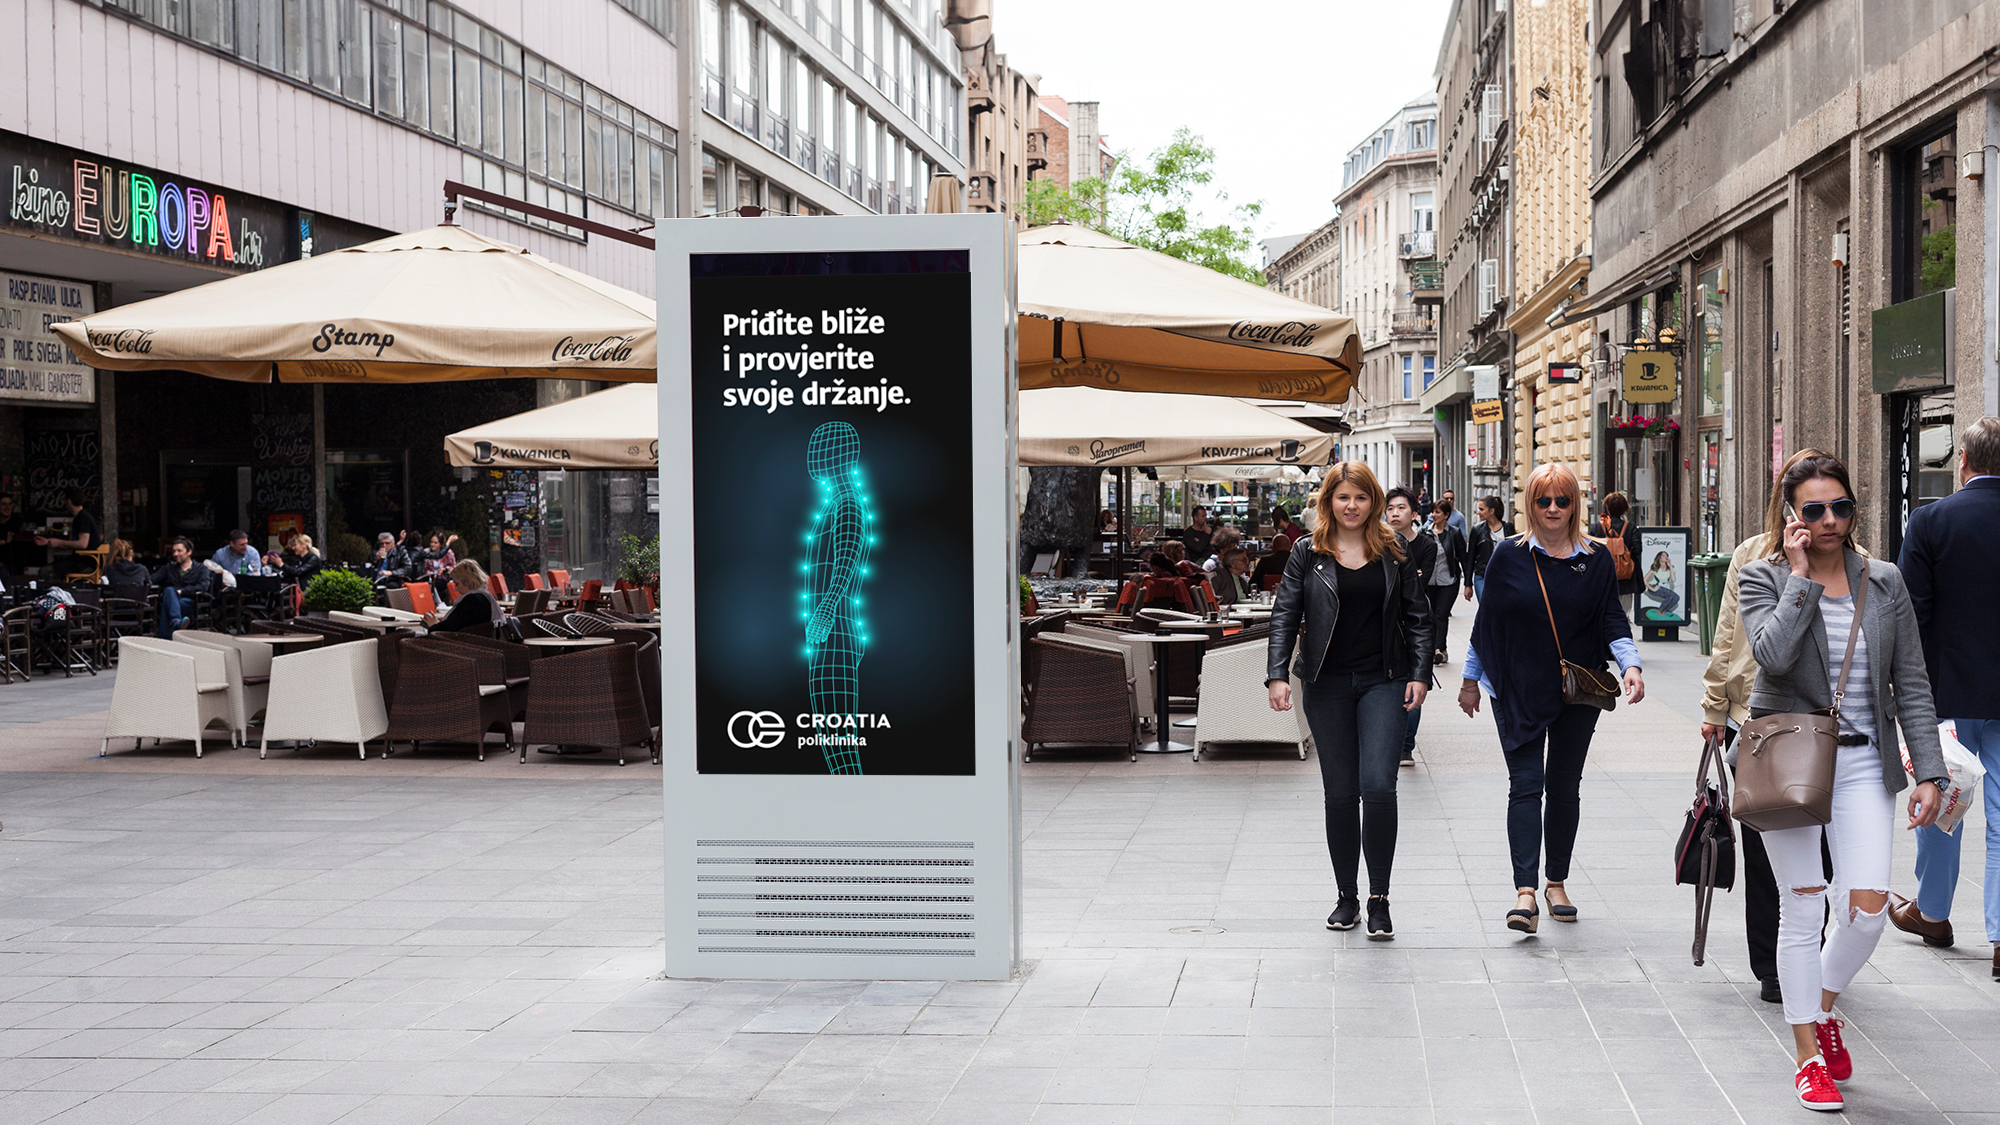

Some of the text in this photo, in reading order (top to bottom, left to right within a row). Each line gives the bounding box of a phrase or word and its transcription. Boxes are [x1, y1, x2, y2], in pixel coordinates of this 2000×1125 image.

[11, 165, 70, 228] kino
[9, 278, 82, 309] RASPJEVANA ULICA
[723, 307, 885, 336] Priđite bliže
[1228, 320, 1322, 347] Coca-Cola
[13, 338, 34, 362] PRIJE
[37, 341, 62, 364] SVEGA
[88, 329, 157, 354] oca-Cola
[312, 323, 395, 357] Stamp
[551, 335, 637, 362] Coca-Cola
[723, 343, 875, 378] i provjerite
[29, 370, 46, 392] MALI
[48, 372, 82, 394] GANGSTER
[1631, 384, 1669, 392] KAVANICA
[723, 378, 911, 414] svoje držanje.
[31, 432, 98, 461] MOJITO
[254, 433, 312, 466] Whiskey
[501, 448, 571, 460] KAVANICA
[1090, 440, 1146, 465] Staropramen
[1201, 446, 1274, 458] KAVANICA
[30, 463, 91, 491] Cuba
[1643, 536, 1671, 548] Disney
[796, 713, 892, 729] CROATIA
[797, 733, 868, 749] poliklinika
[1945, 787, 1962, 816] KONZUM
